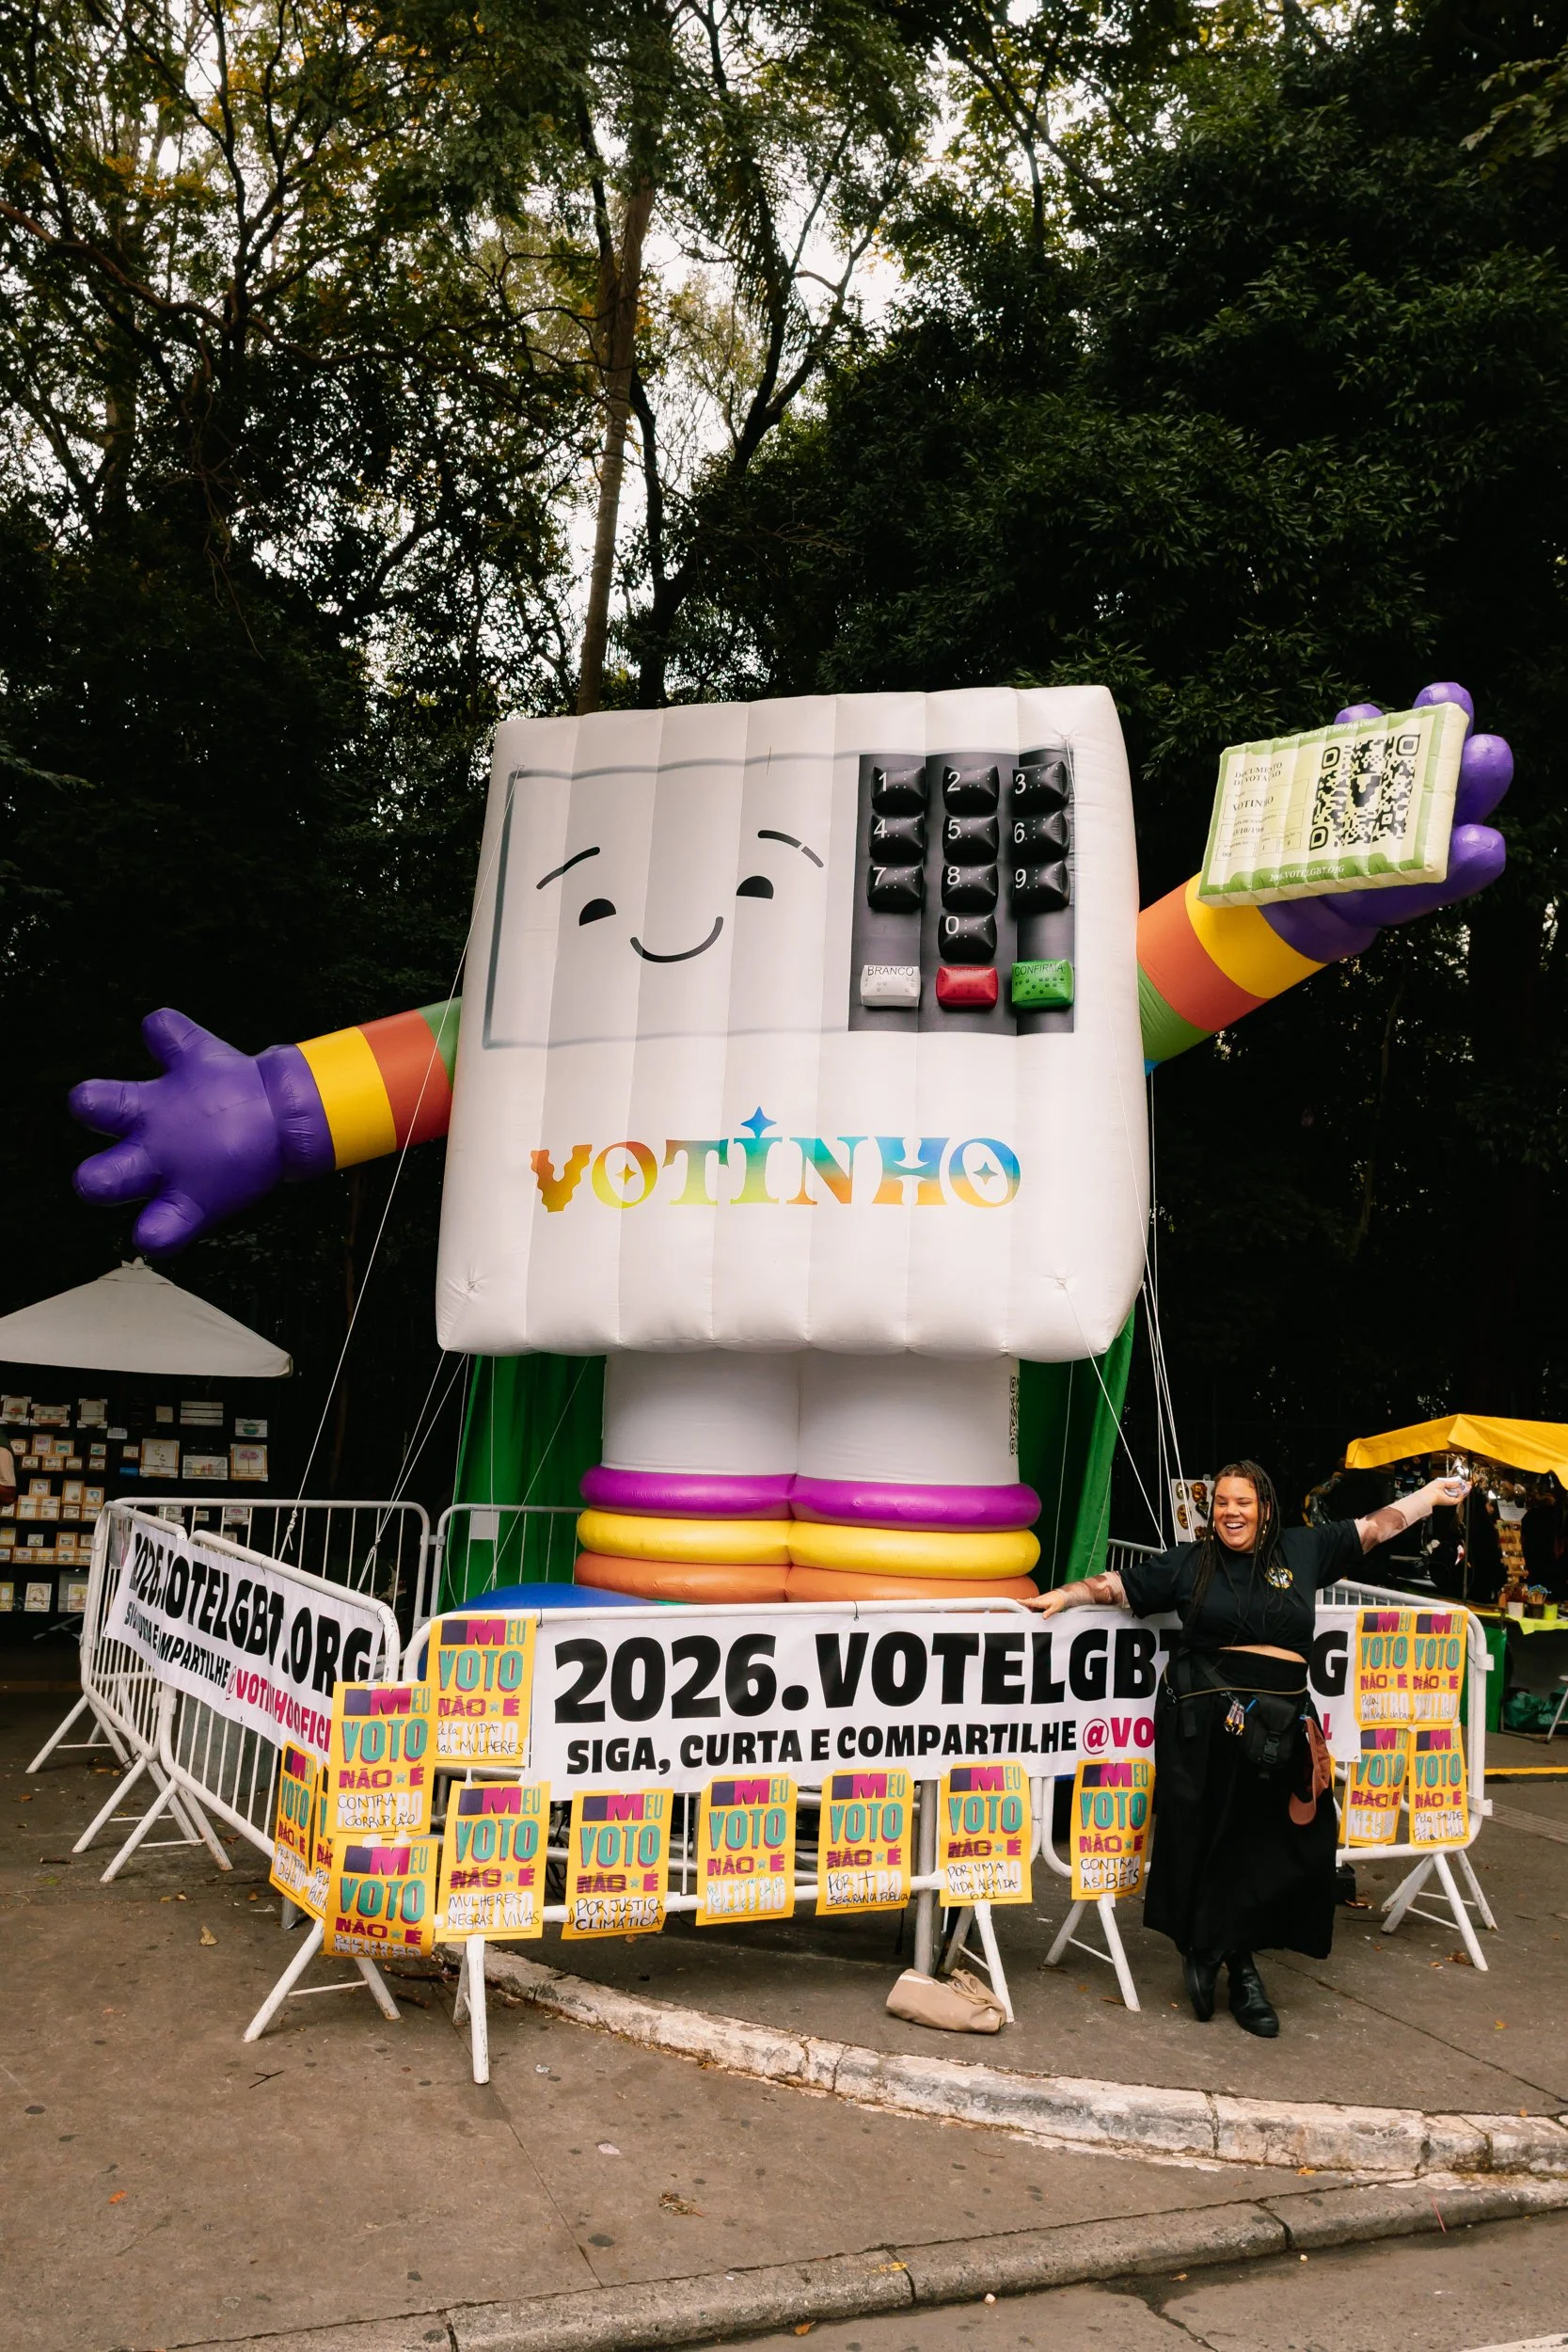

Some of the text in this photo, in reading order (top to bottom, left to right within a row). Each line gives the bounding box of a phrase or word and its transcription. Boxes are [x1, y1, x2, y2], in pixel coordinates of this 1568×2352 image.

[879, 771, 1027, 794] 1 2 3
[873, 818, 1025, 843] 4 5 6
[872, 866, 1027, 889] 7 8 9
[945, 915, 959, 935] 0
[867, 965, 914, 976] BRANCO
[1015, 963, 1064, 977] CONFIRMA
[530, 1106, 1022, 1213] VOTINHO
[467, 1619, 527, 1645] MEU
[1377, 1612, 1411, 1632] MEU
[1431, 1613, 1463, 1633] MEU
[157, 1629, 231, 1690] MPARTILHE
[1361, 1635, 1408, 1669] VOTO
[1415, 1638, 1461, 1671] VOTO
[438, 1649, 524, 1692] VOTO
[554, 1628, 1348, 1724] 2026.VOTELGBG
[1360, 1673, 1387, 1690] NÃO
[371, 1688, 430, 1715] MEU
[342, 1719, 429, 1764] VOTO
[467, 1723, 499, 1736] VIDA
[460, 1740, 524, 1755] MULHERES
[566, 1737, 671, 1775] SIGA,
[680, 1729, 802, 1768] CURTA
[811, 1728, 830, 1761] E
[837, 1720, 1076, 1758] COMPARTILHE
[339, 1769, 392, 1788] NÃO
[971, 1766, 1022, 1791] MEU
[1101, 1763, 1148, 1788] MEU
[1356, 1754, 1405, 1788] VOTO
[1416, 1754, 1461, 1788] VOTO
[735, 1779, 789, 1805] MEU
[852, 1773, 906, 1799] MEU
[280, 1774, 309, 1830] VOTO
[337, 1793, 397, 1810] CONTRA
[483, 1788, 541, 1815] MEU
[607, 1794, 663, 1820] MEU
[1080, 1791, 1148, 1830] VOTO
[345, 1811, 416, 1832] CORRUPÇÃO
[830, 1803, 903, 1844] VOTO
[948, 1795, 1023, 1836] VOTO
[455, 1819, 539, 1864] VOTO
[709, 1807, 786, 1851] VOTO
[580, 1825, 661, 1868] VOTO
[1079, 1834, 1122, 1853] NÃO
[371, 1846, 429, 1875] MEU
[707, 1855, 754, 1877] NÃO
[947, 1862, 1004, 1879] POR UMA
[1081, 1858, 1132, 1871] CONTRA
[828, 1870, 854, 1894] POR
[950, 1881, 974, 1893] VIDA
[1004, 1878, 1019, 1889] DA
[1084, 1868, 1139, 1890] AS BETS
[340, 1877, 425, 1924] VOTO
[449, 1893, 522, 1909] MULHERES
[576, 1897, 663, 1915] POR JUSTIÇA
[335, 1917, 388, 1938] NÃO
[404, 1926, 423, 1945] É
[448, 1911, 540, 1928] NEGRAS VIVAS
[576, 1913, 663, 1931] CLIMÁTICA
